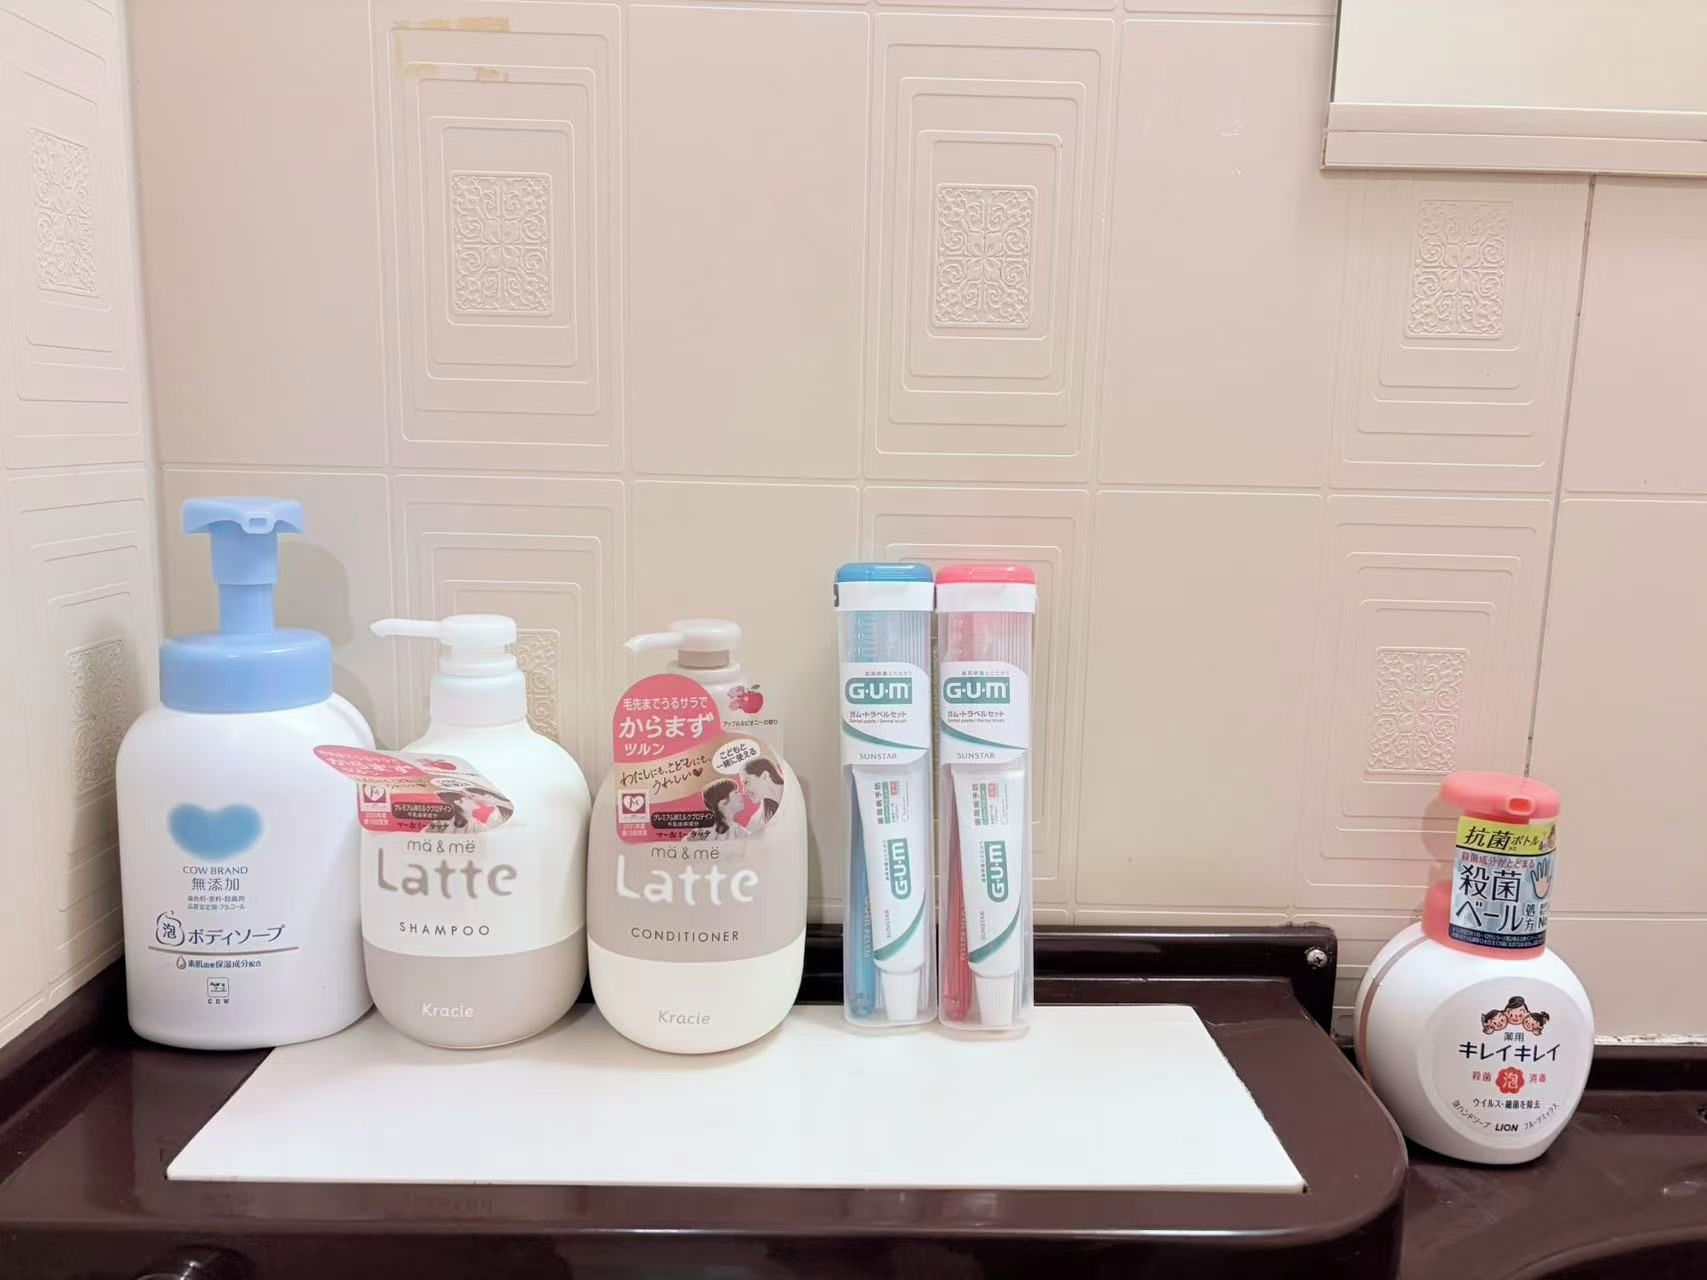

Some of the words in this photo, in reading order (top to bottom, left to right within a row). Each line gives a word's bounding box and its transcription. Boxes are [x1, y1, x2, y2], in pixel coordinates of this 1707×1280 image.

[623, 696, 708, 711] 毛先までうるサラで
[619, 713, 714, 738] からまず
[625, 743, 665, 756] ツルン
[719, 743, 748, 761] こどもと
[859, 752, 897, 760] SUNSTAR
[957, 752, 995, 760] SUNSTAR
[716, 749, 757, 770] 一緒に使える
[183, 866, 208, 875] COW
[210, 866, 249, 875] BRAND
[378, 847, 518, 900] Latte
[191, 877, 240, 891] 無添加
[616, 854, 760, 906] Latte
[1458, 864, 1522, 903] 殺菌
[1455, 900, 1524, 932] ベール
[162, 922, 177, 939] 泡
[188, 924, 286, 946] ボディソープ
[399, 921, 490, 936] SHAMPOO
[631, 927, 739, 944] CONDITIONER
[422, 1003, 474, 1017] Kracie
[658, 1010, 711, 1025] Kracie
[1503, 1032, 1525, 1042] 薬用
[1458, 1041, 1560, 1062] キレイキレイ
[1472, 1071, 1492, 1082] 殺菌
[1502, 1072, 1519, 1089] 泡
[1472, 1098, 1540, 1109] ウイルス・細菌を除去
[1495, 1123, 1519, 1132] LION
